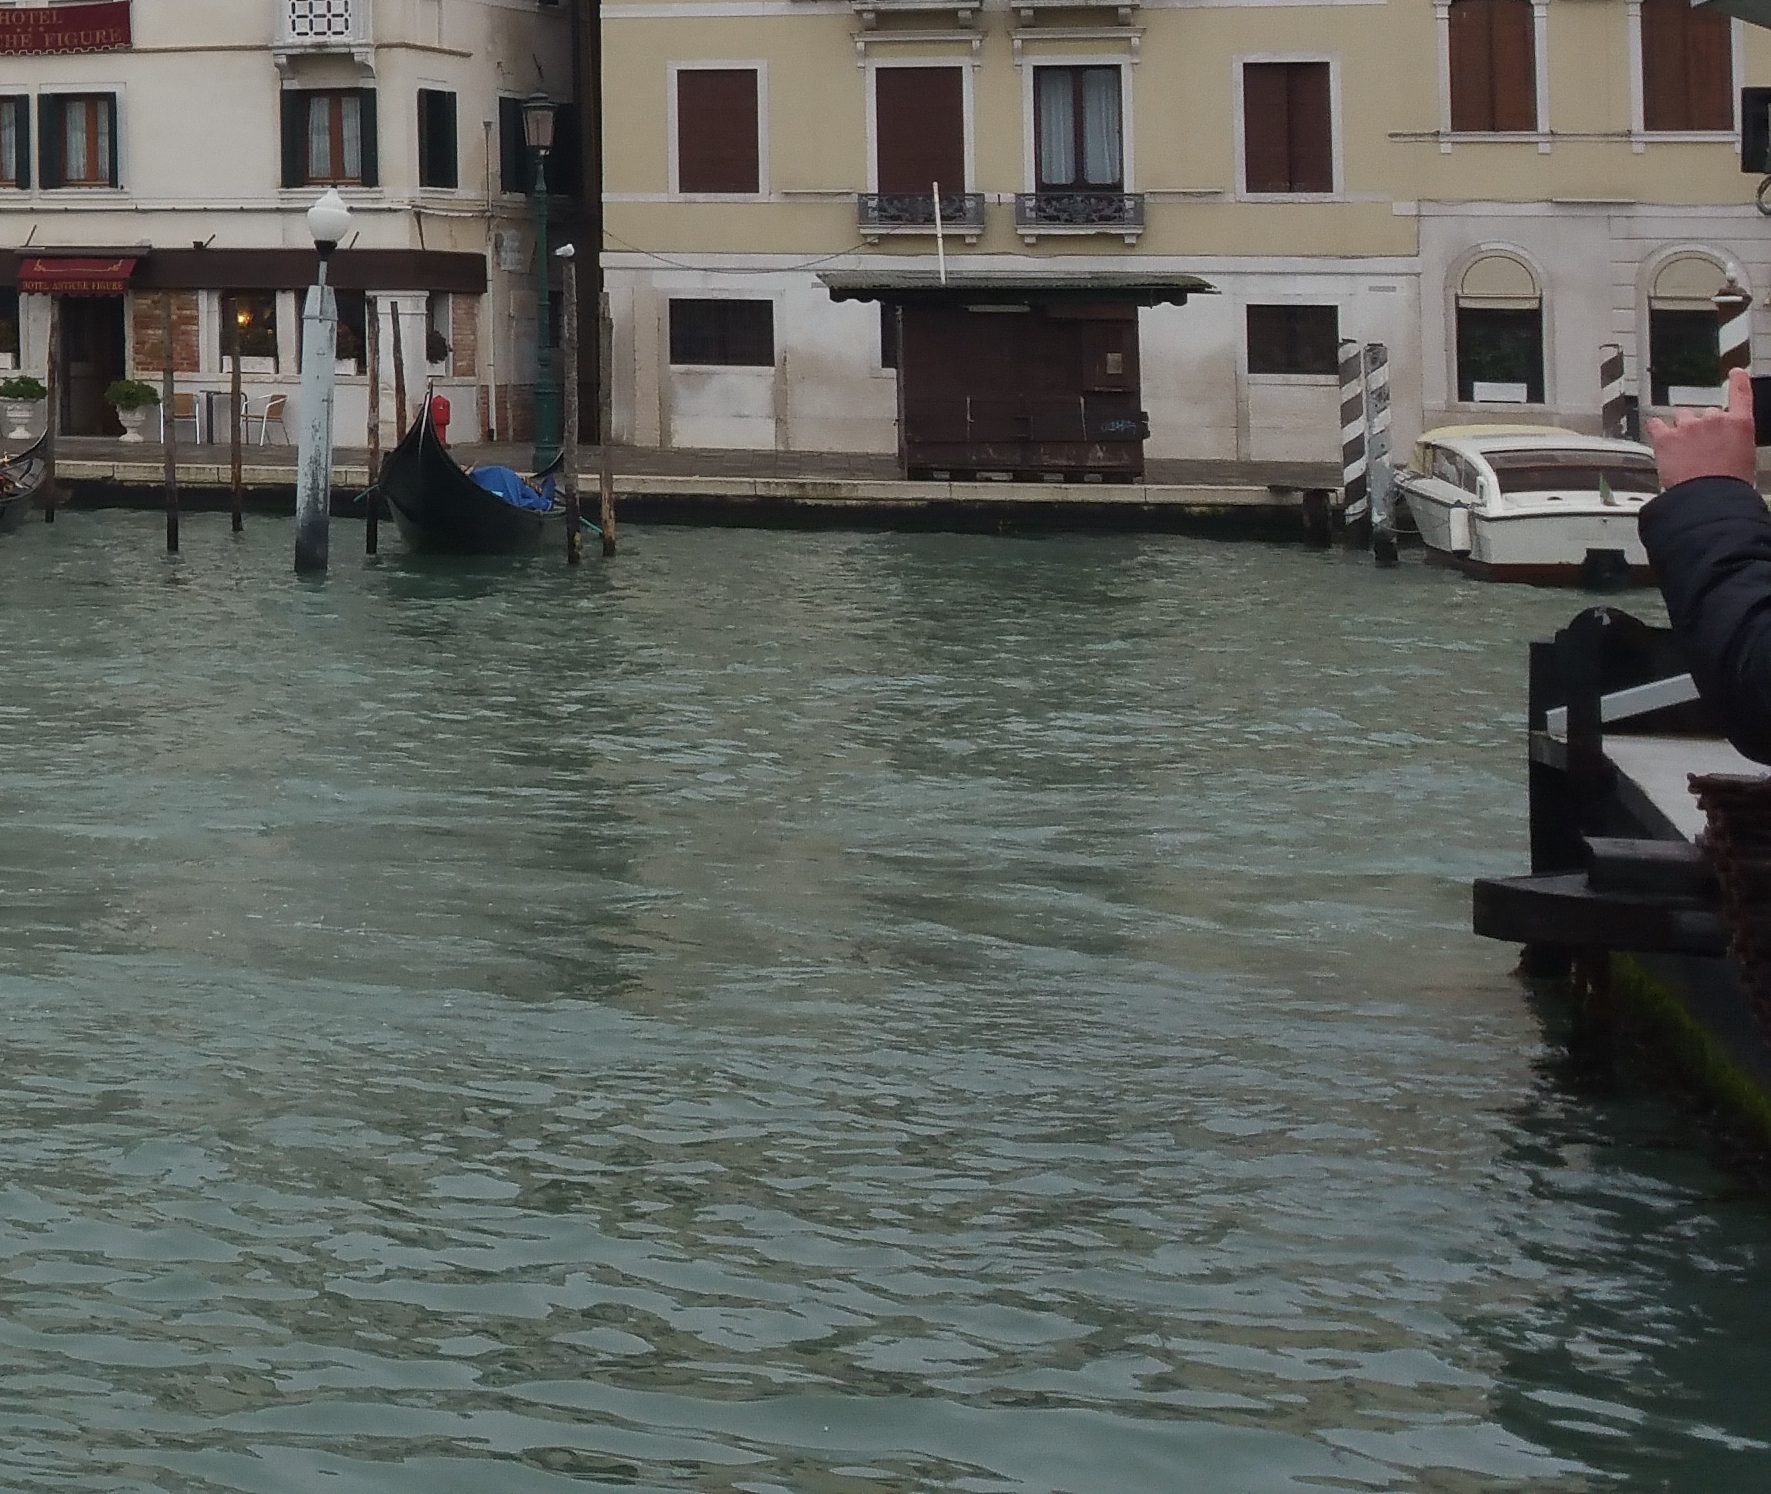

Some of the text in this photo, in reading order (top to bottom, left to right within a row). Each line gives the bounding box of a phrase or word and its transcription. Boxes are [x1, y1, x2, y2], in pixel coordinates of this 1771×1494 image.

[44, 28, 123, 47] FIGURE
[22, 281, 123, 290] HOTEL ANTICHE FIGURE
